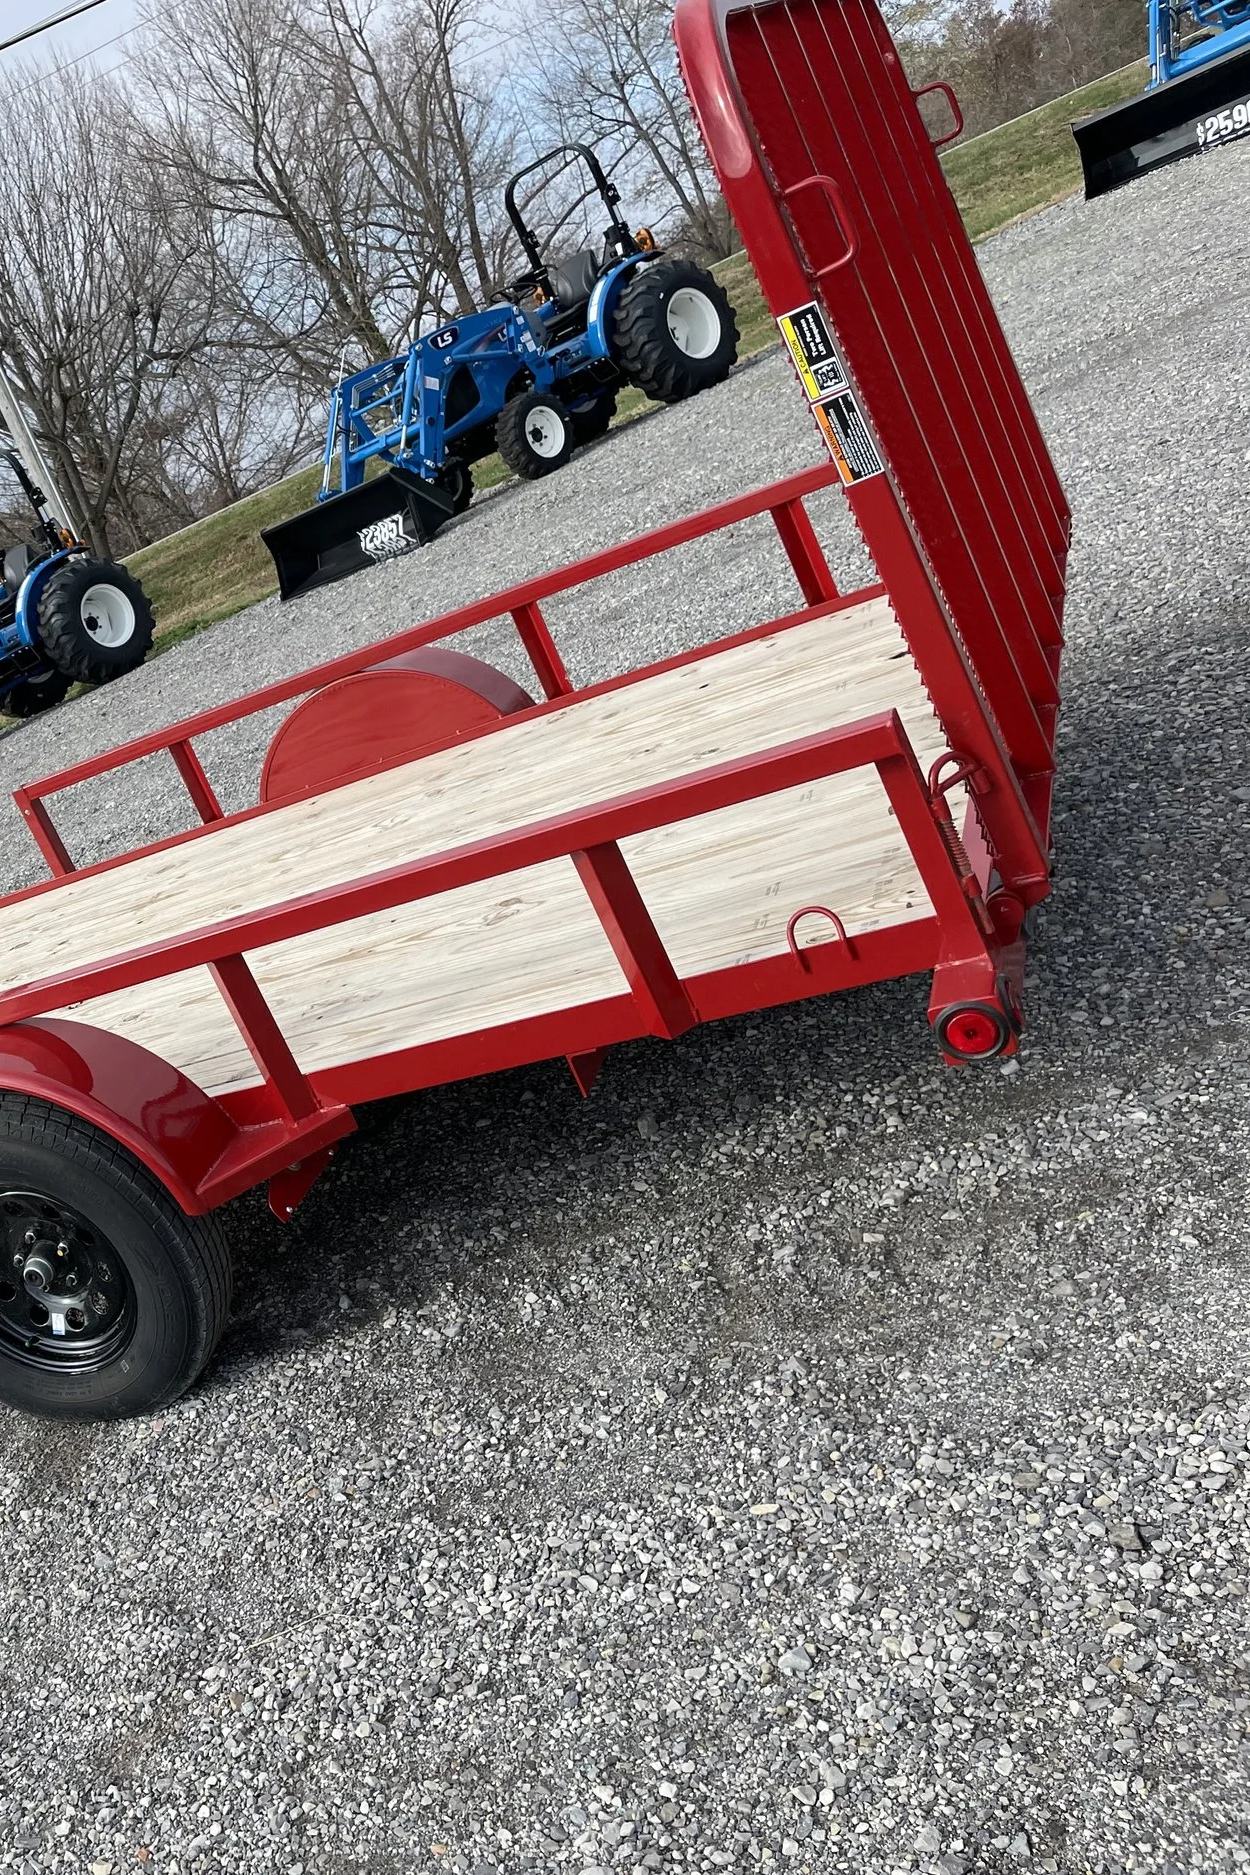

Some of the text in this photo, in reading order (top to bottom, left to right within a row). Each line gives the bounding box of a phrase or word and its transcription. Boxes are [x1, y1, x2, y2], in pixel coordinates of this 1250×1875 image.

[1196, 100, 1250, 146] $259
[437, 332, 453, 348] LS
[800, 318, 814, 343] Person
[805, 313, 821, 343] Required
[790, 338, 807, 369] CAUTION
[809, 341, 819, 357] Two
[816, 341, 826, 356] Lift
[824, 425, 840, 456] WARNING
